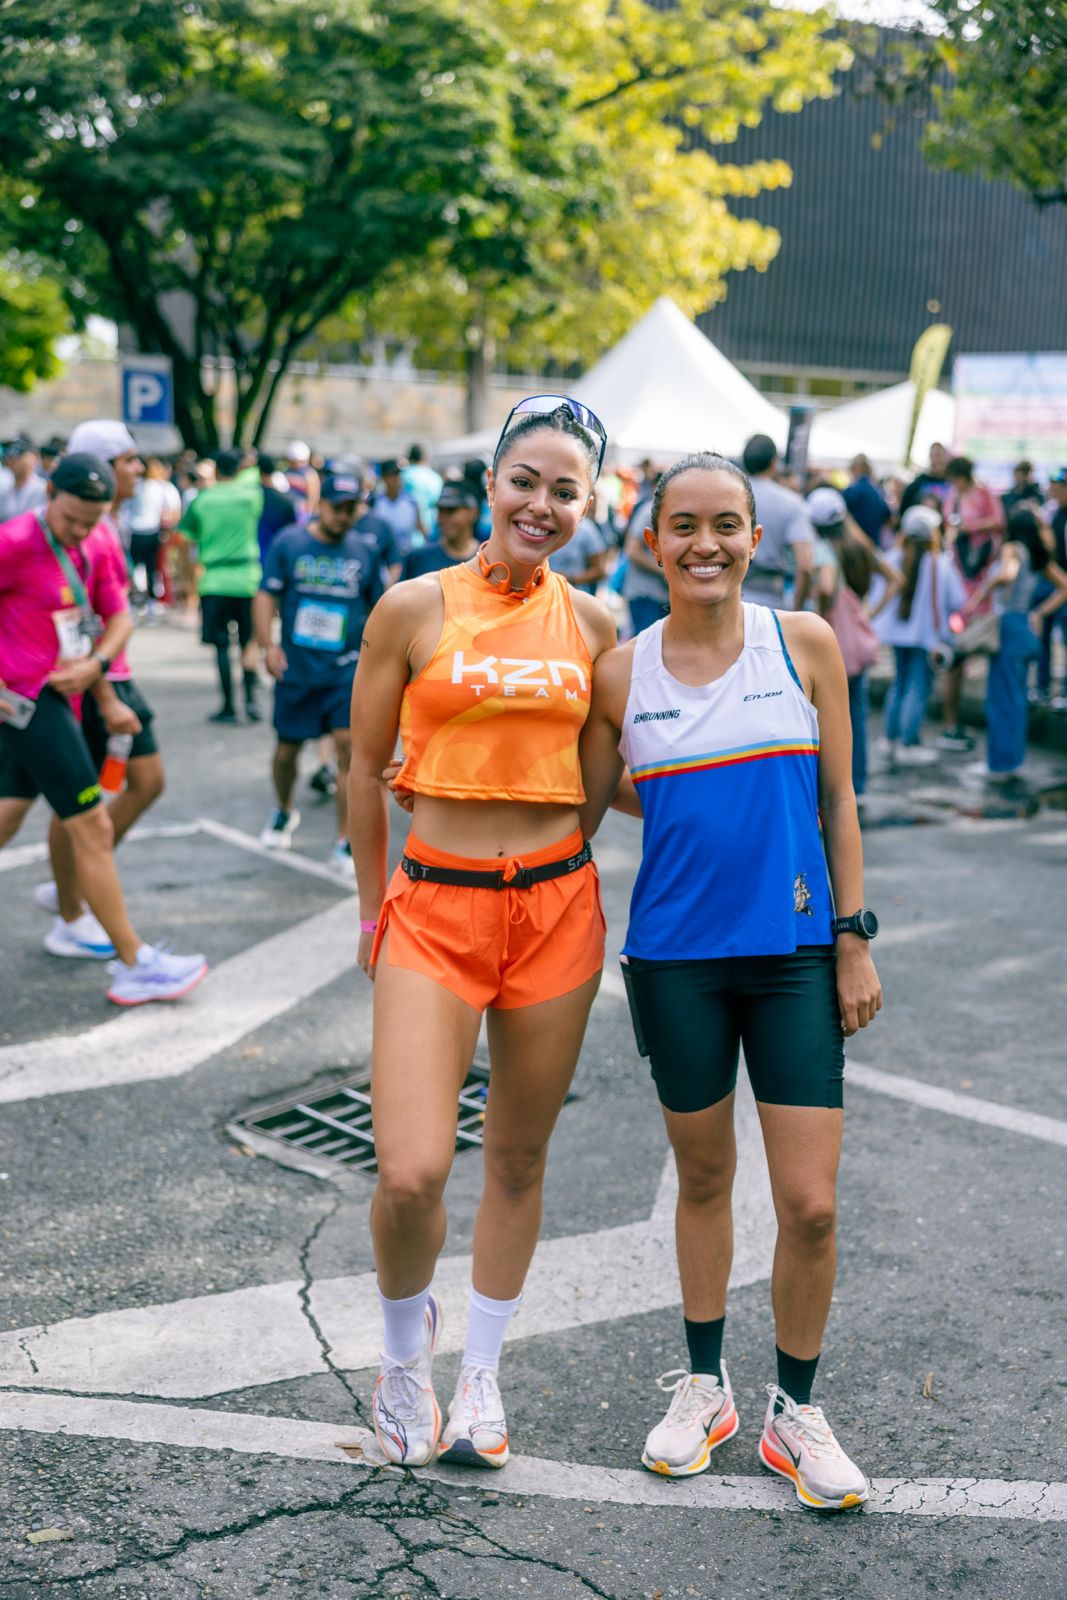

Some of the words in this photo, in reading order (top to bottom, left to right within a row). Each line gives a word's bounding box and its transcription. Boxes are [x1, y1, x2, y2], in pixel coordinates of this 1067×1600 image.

[128, 375, 163, 419] P
[470, 684, 579, 702] TEAM
[633, 709, 681, 724] BMRUNNING
